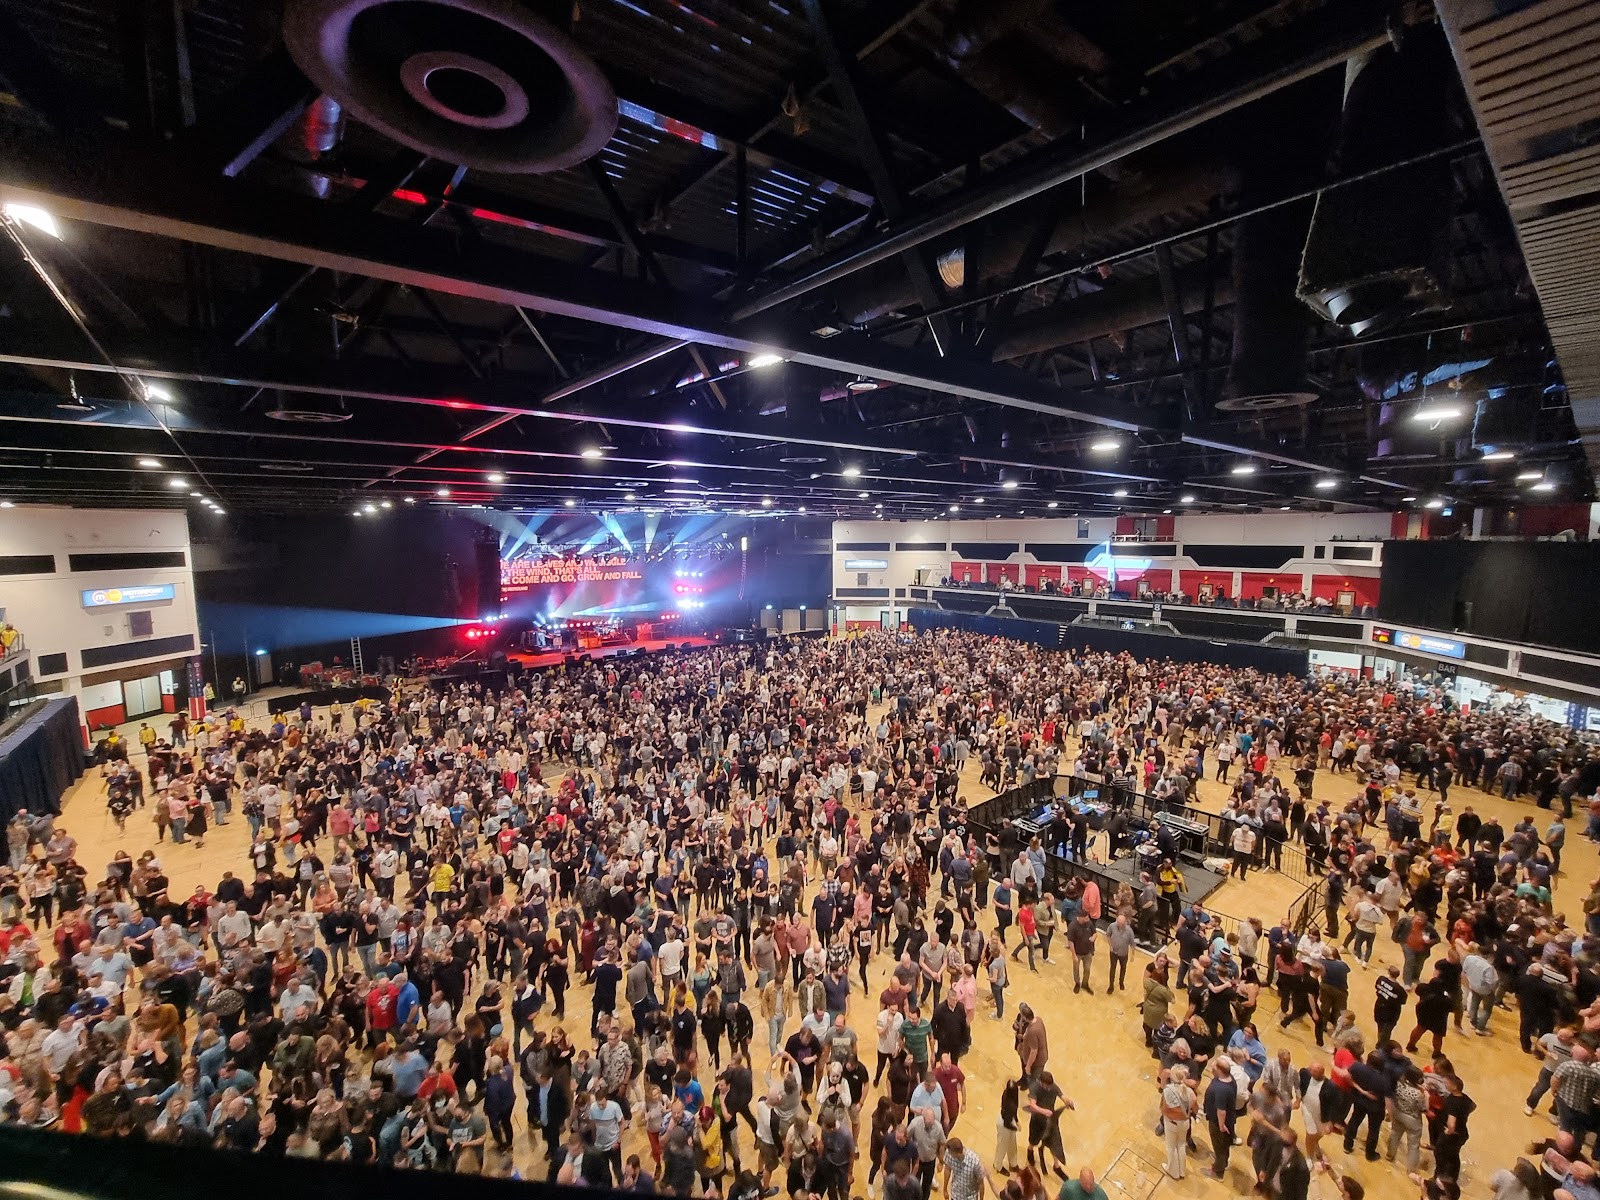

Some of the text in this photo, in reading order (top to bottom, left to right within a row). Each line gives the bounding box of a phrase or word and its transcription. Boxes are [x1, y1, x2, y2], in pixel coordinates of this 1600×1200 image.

[511, 560, 531, 569] ARE
[506, 569, 526, 577] THE
[512, 575, 540, 585] COME
[541, 573, 560, 584] AND
[561, 573, 577, 583] GO,
[578, 572, 603, 581] GROW
[604, 571, 621, 581] AND
[1438, 663, 1456, 675] BAR
